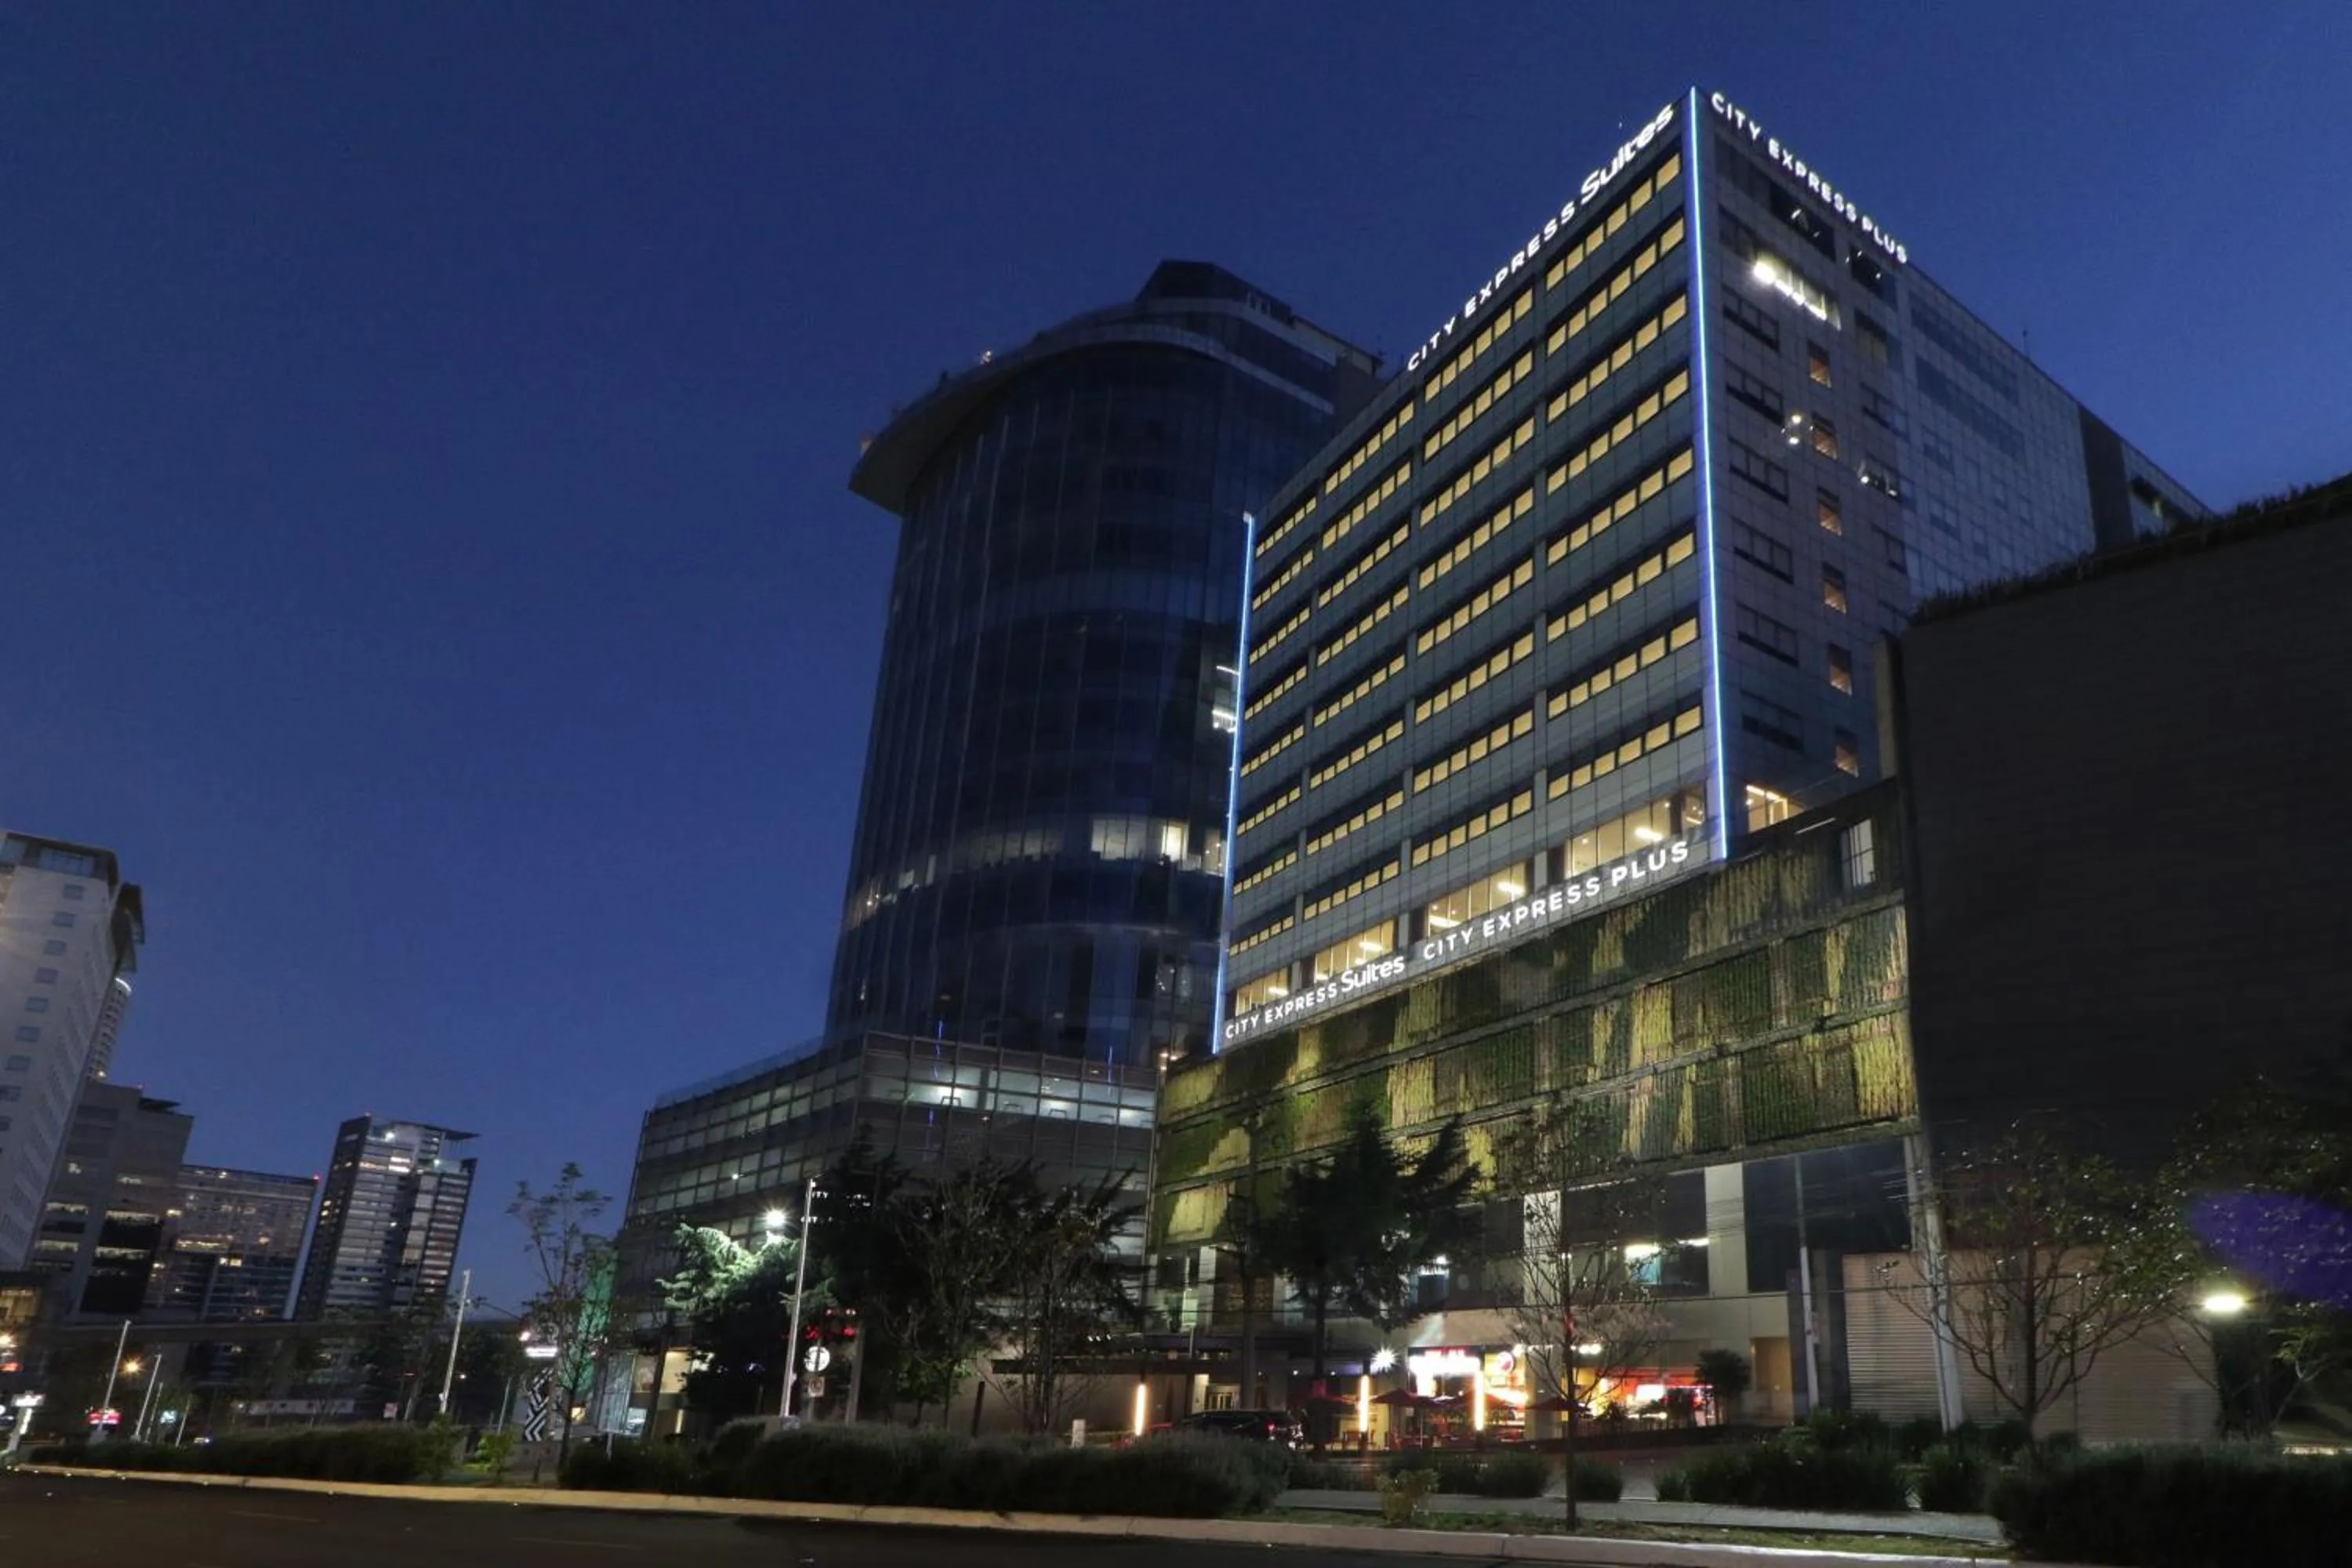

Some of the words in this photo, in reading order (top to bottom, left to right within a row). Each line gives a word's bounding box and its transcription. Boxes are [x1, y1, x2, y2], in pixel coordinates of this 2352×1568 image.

[1407, 316, 1456, 372] CITY
[1465, 200, 1576, 318] EXPRESS
[1580, 103, 1674, 205] Suites
[1711, 92, 1761, 141] CITY
[1769, 137, 1857, 223] EXPRESS
[1862, 215, 1907, 264] PLUS
[1422, 927, 1474, 960] CITY
[1482, 877, 1600, 938] EXPRESS
[1611, 840, 1689, 887] PLUS
[1225, 1014, 1261, 1040] CITY
[1264, 982, 1338, 1024] EXPRESS
[1340, 955, 1406, 993] Suites
